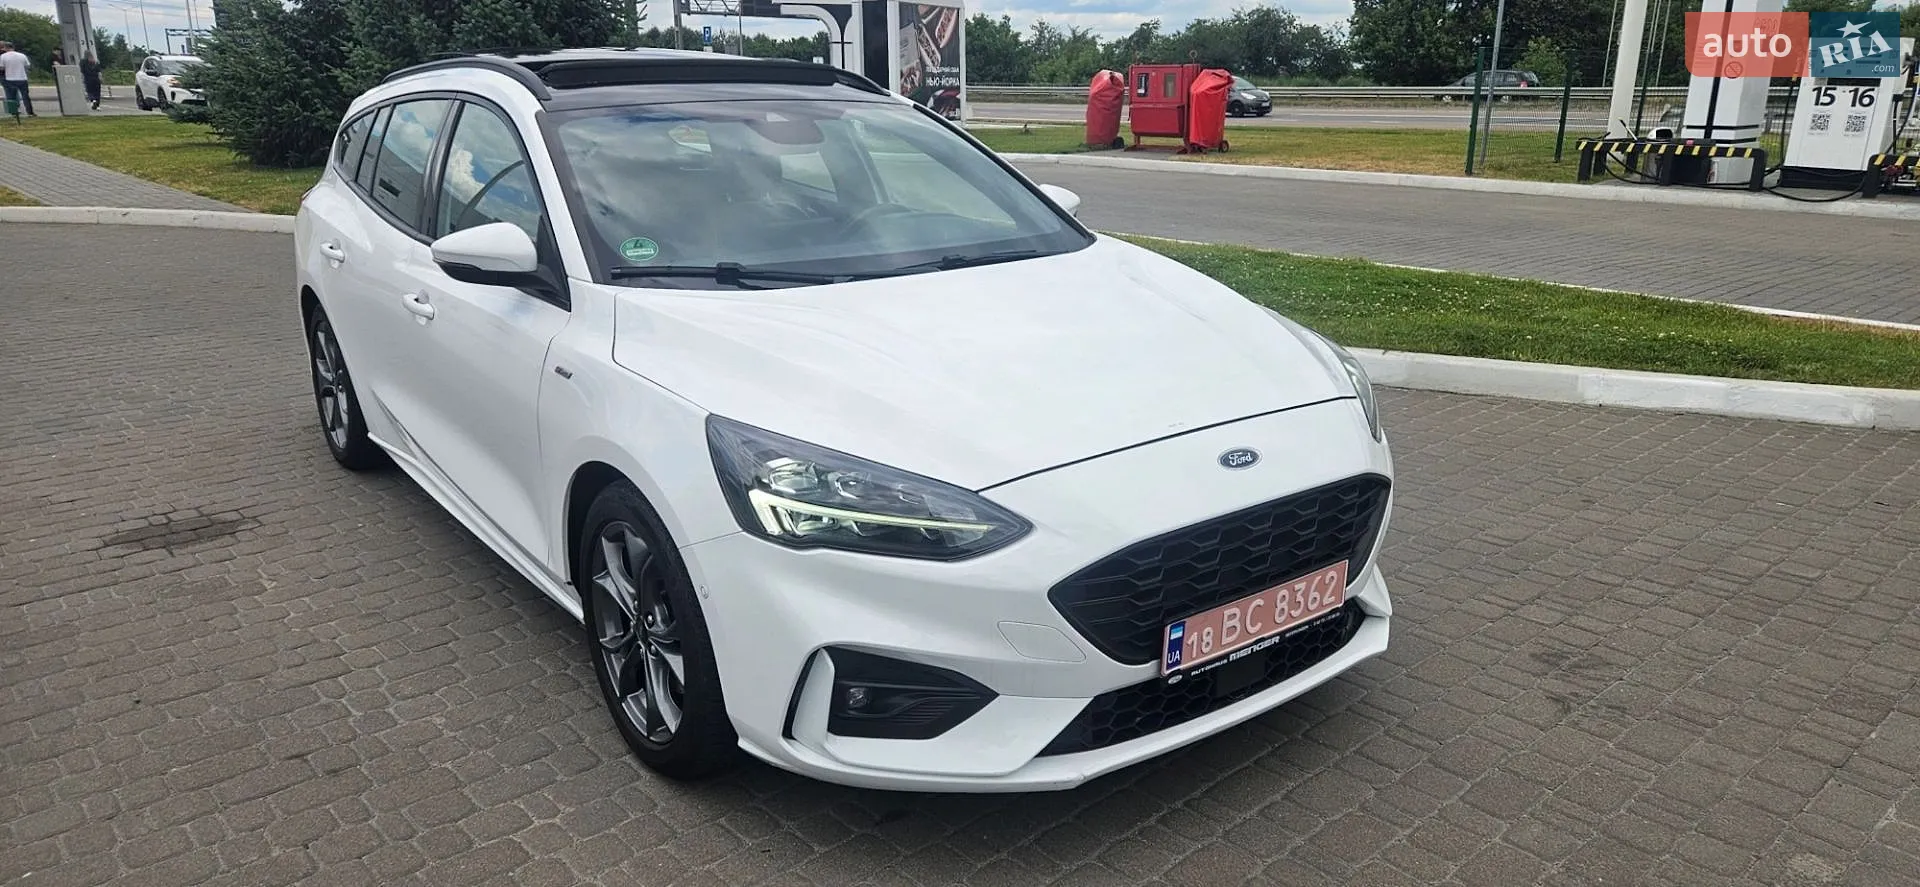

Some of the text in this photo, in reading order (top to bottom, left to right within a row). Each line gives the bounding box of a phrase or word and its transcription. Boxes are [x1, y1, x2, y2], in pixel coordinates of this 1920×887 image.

[704, 28, 710, 41] P
[925, 75, 960, 87] НЬЮ-ЙОРКА
[1812, 86, 1875, 107] 15 16
[1229, 452, 1253, 466] Ford
[1186, 570, 1338, 659] 18 BC 8362
[1167, 649, 1181, 664] UA
